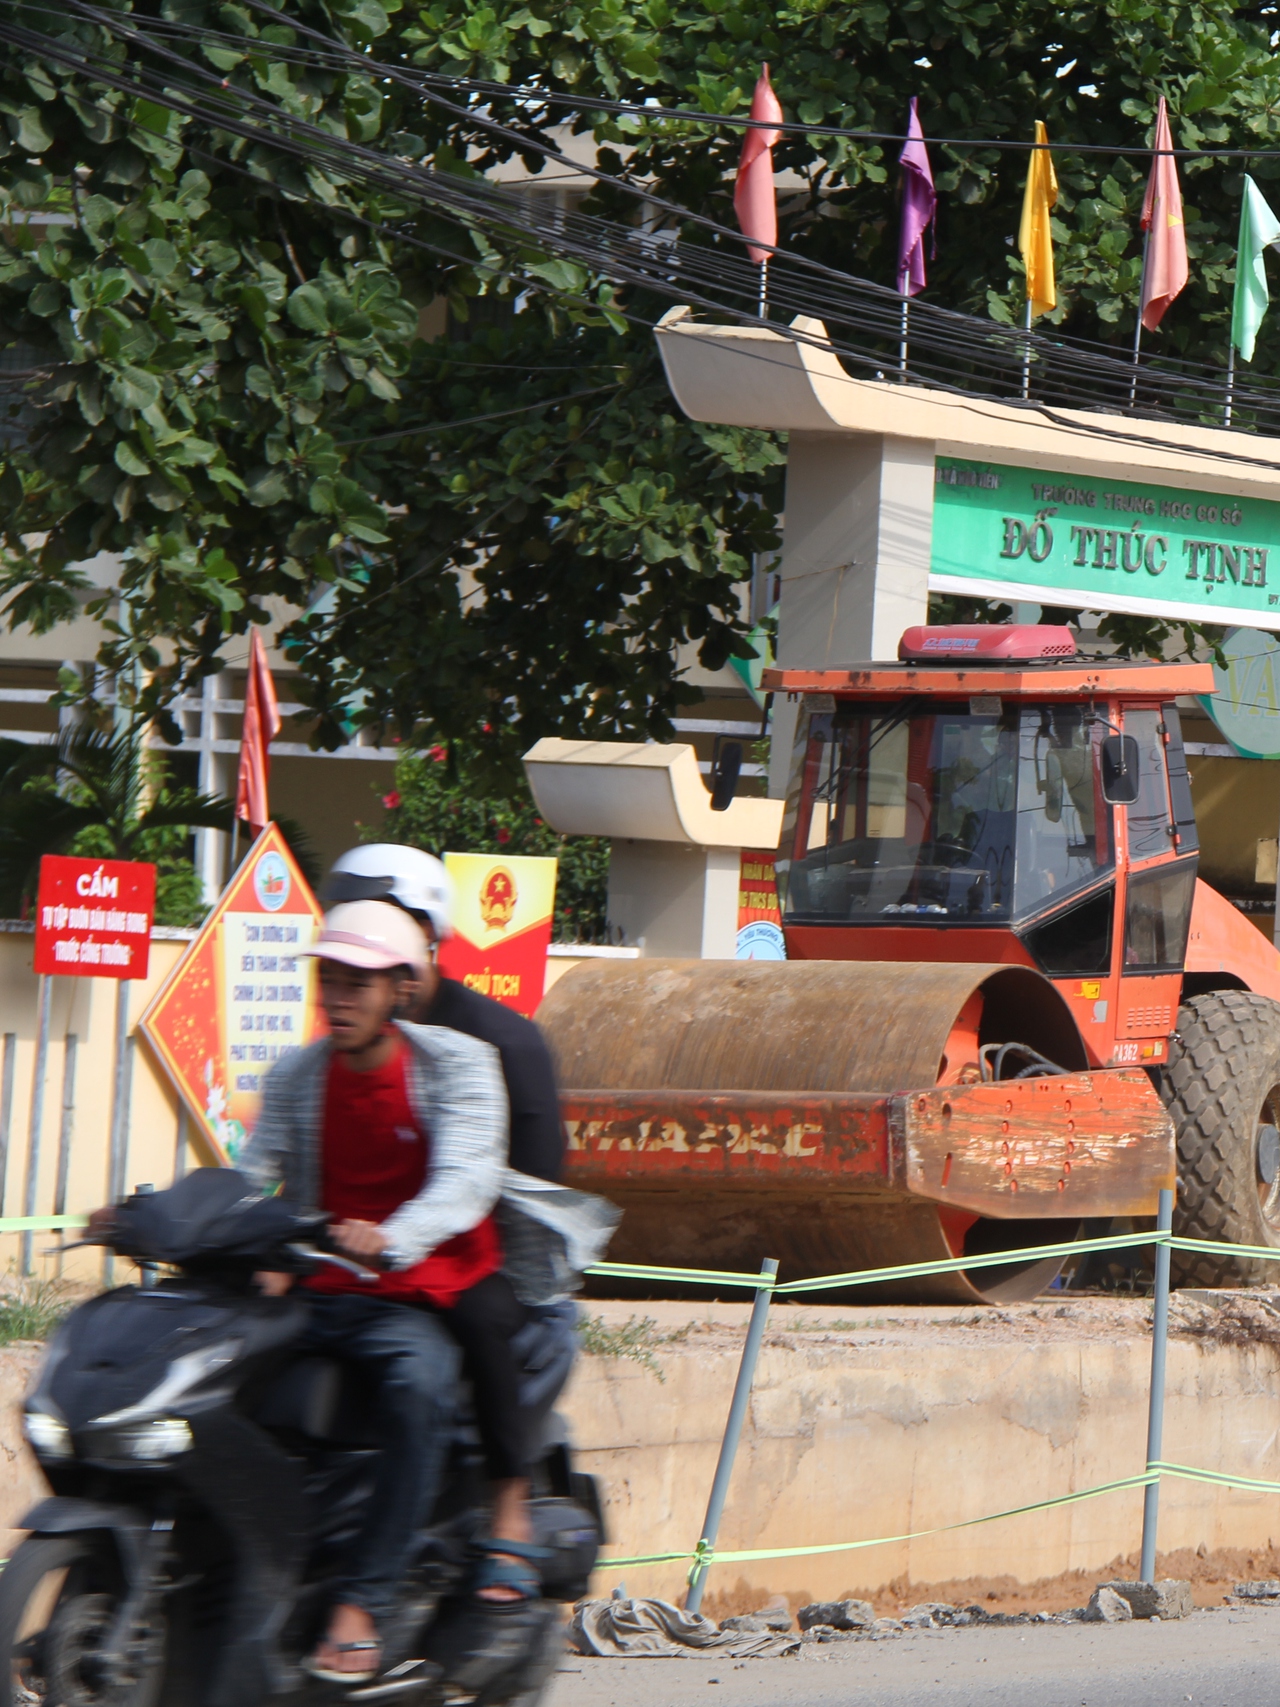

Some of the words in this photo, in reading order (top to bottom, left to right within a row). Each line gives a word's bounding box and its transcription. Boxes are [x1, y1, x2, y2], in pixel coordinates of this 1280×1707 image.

[1031, 480, 1097, 508] TRƯỜNG
[1103, 492, 1155, 515] TRUNG
[1160, 501, 1193, 524] HỌC
[1197, 504, 1219, 523] CƠ
[1221, 502, 1243, 526] SỞ
[1000, 506, 1059, 563] ĐỖ
[1070, 521, 1169, 576] THÚC
[1183, 538, 1269, 593] TỊNH
[76, 864, 119, 898] CẤM
[492, 974, 521, 1001] TỊCH
